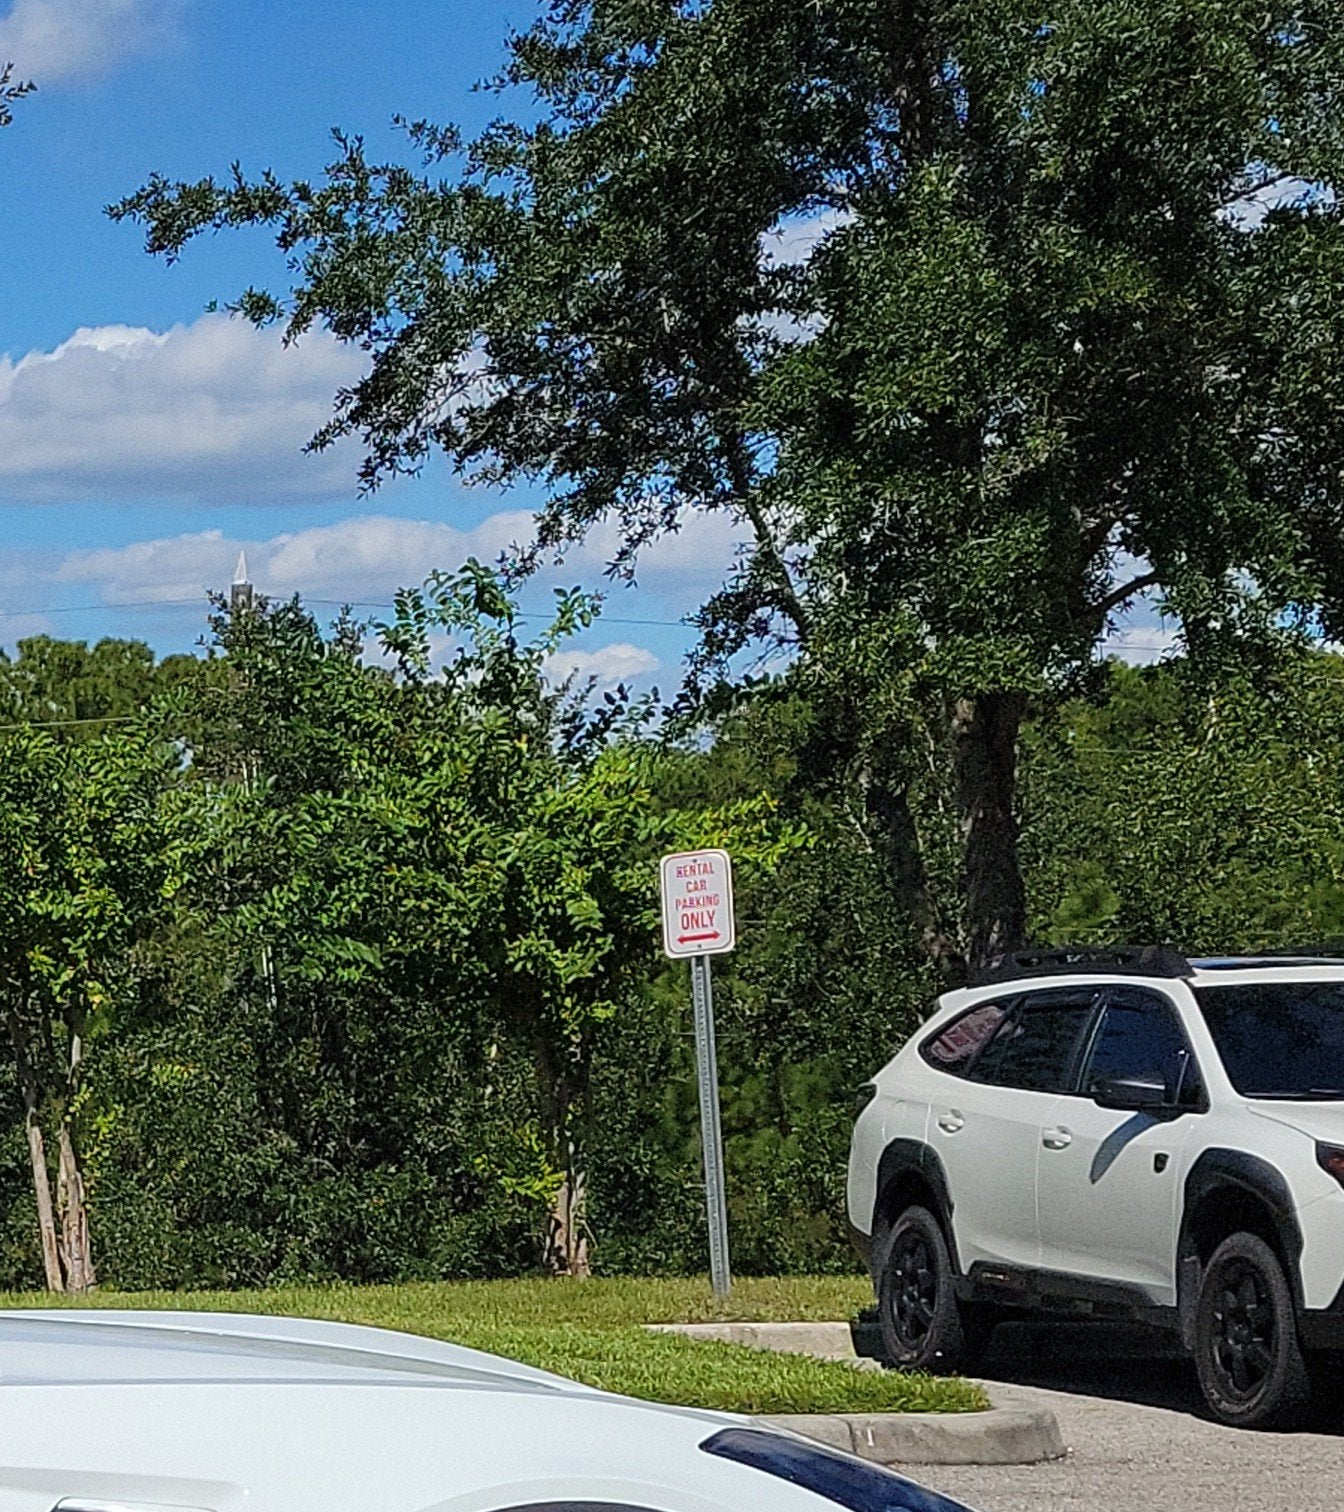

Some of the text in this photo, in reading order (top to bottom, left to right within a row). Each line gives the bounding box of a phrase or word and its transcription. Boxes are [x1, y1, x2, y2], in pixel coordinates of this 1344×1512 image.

[677, 862, 714, 877] RENTAL
[685, 880, 707, 893] CAR
[675, 894, 720, 911] PARKING
[681, 911, 716, 930] ONLY
